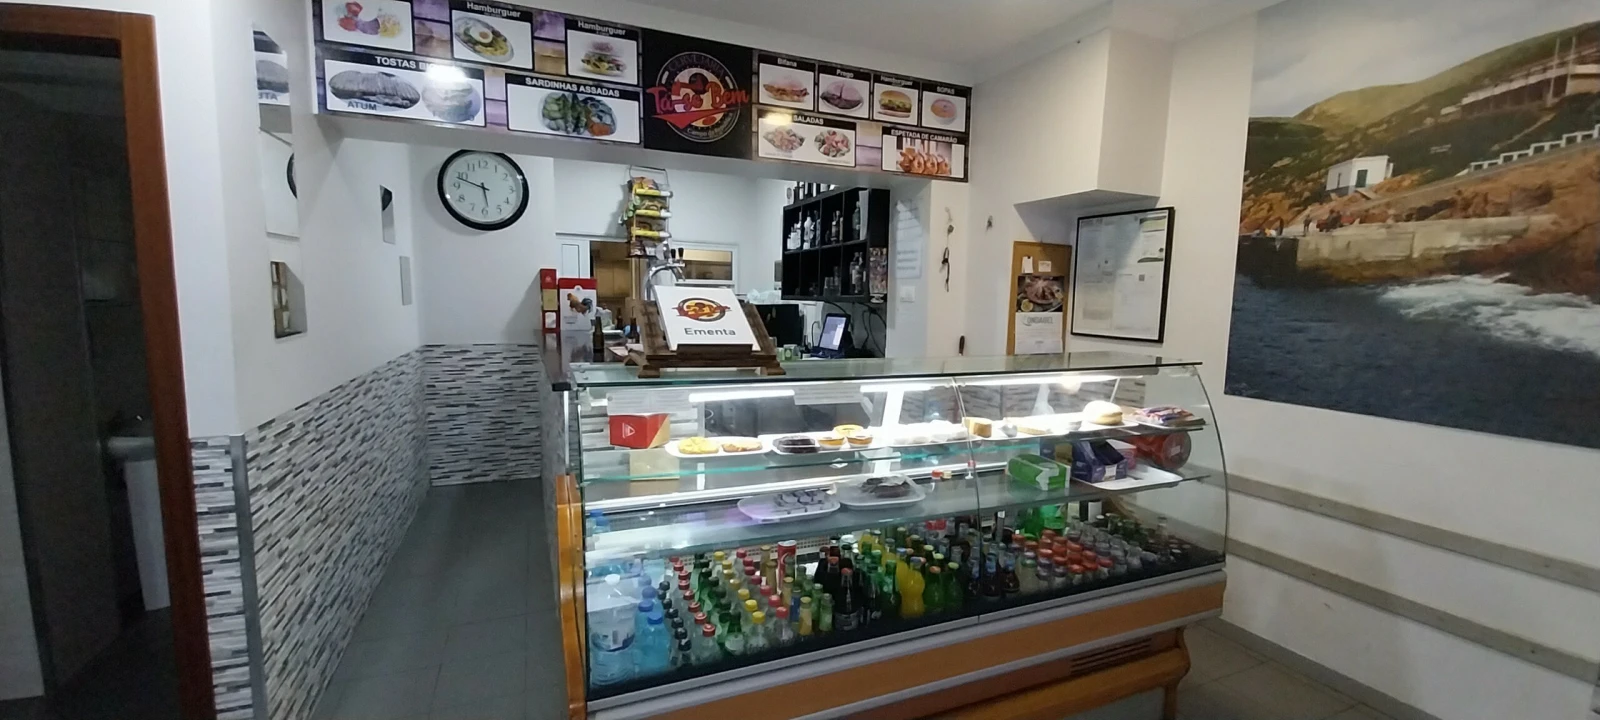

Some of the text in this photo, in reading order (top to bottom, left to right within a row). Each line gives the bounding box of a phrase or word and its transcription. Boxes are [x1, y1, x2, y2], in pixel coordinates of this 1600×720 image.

[466, 2, 521, 18] Hamburguer
[577, 20, 626, 36] Hamburguer
[375, 56, 416, 70] TOSTAS
[777, 57, 797, 67] Bifana
[836, 68, 854, 79] Prego
[880, 75, 913, 87] Hamburguer
[525, 77, 620, 98] SARDINHAS ASSADAS
[936, 85, 955, 95] SOPAS
[705, 81, 750, 109] Bem
[347, 101, 377, 111] ATUM
[793, 115, 824, 125] SALADAS
[890, 129, 920, 139] ESPETADA
[929, 134, 958, 144] CAMARÃO
[467, 162, 476, 172] 11
[478, 160, 489, 170] 12
[502, 173, 509, 182] 2
[453, 182, 461, 190] 9
[508, 186, 515, 195] 3
[457, 194, 466, 203] 8
[503, 196, 510, 205] 4
[481, 207, 489, 216] 6
[495, 205, 502, 215] 5
[684, 327, 736, 336] Ementa
